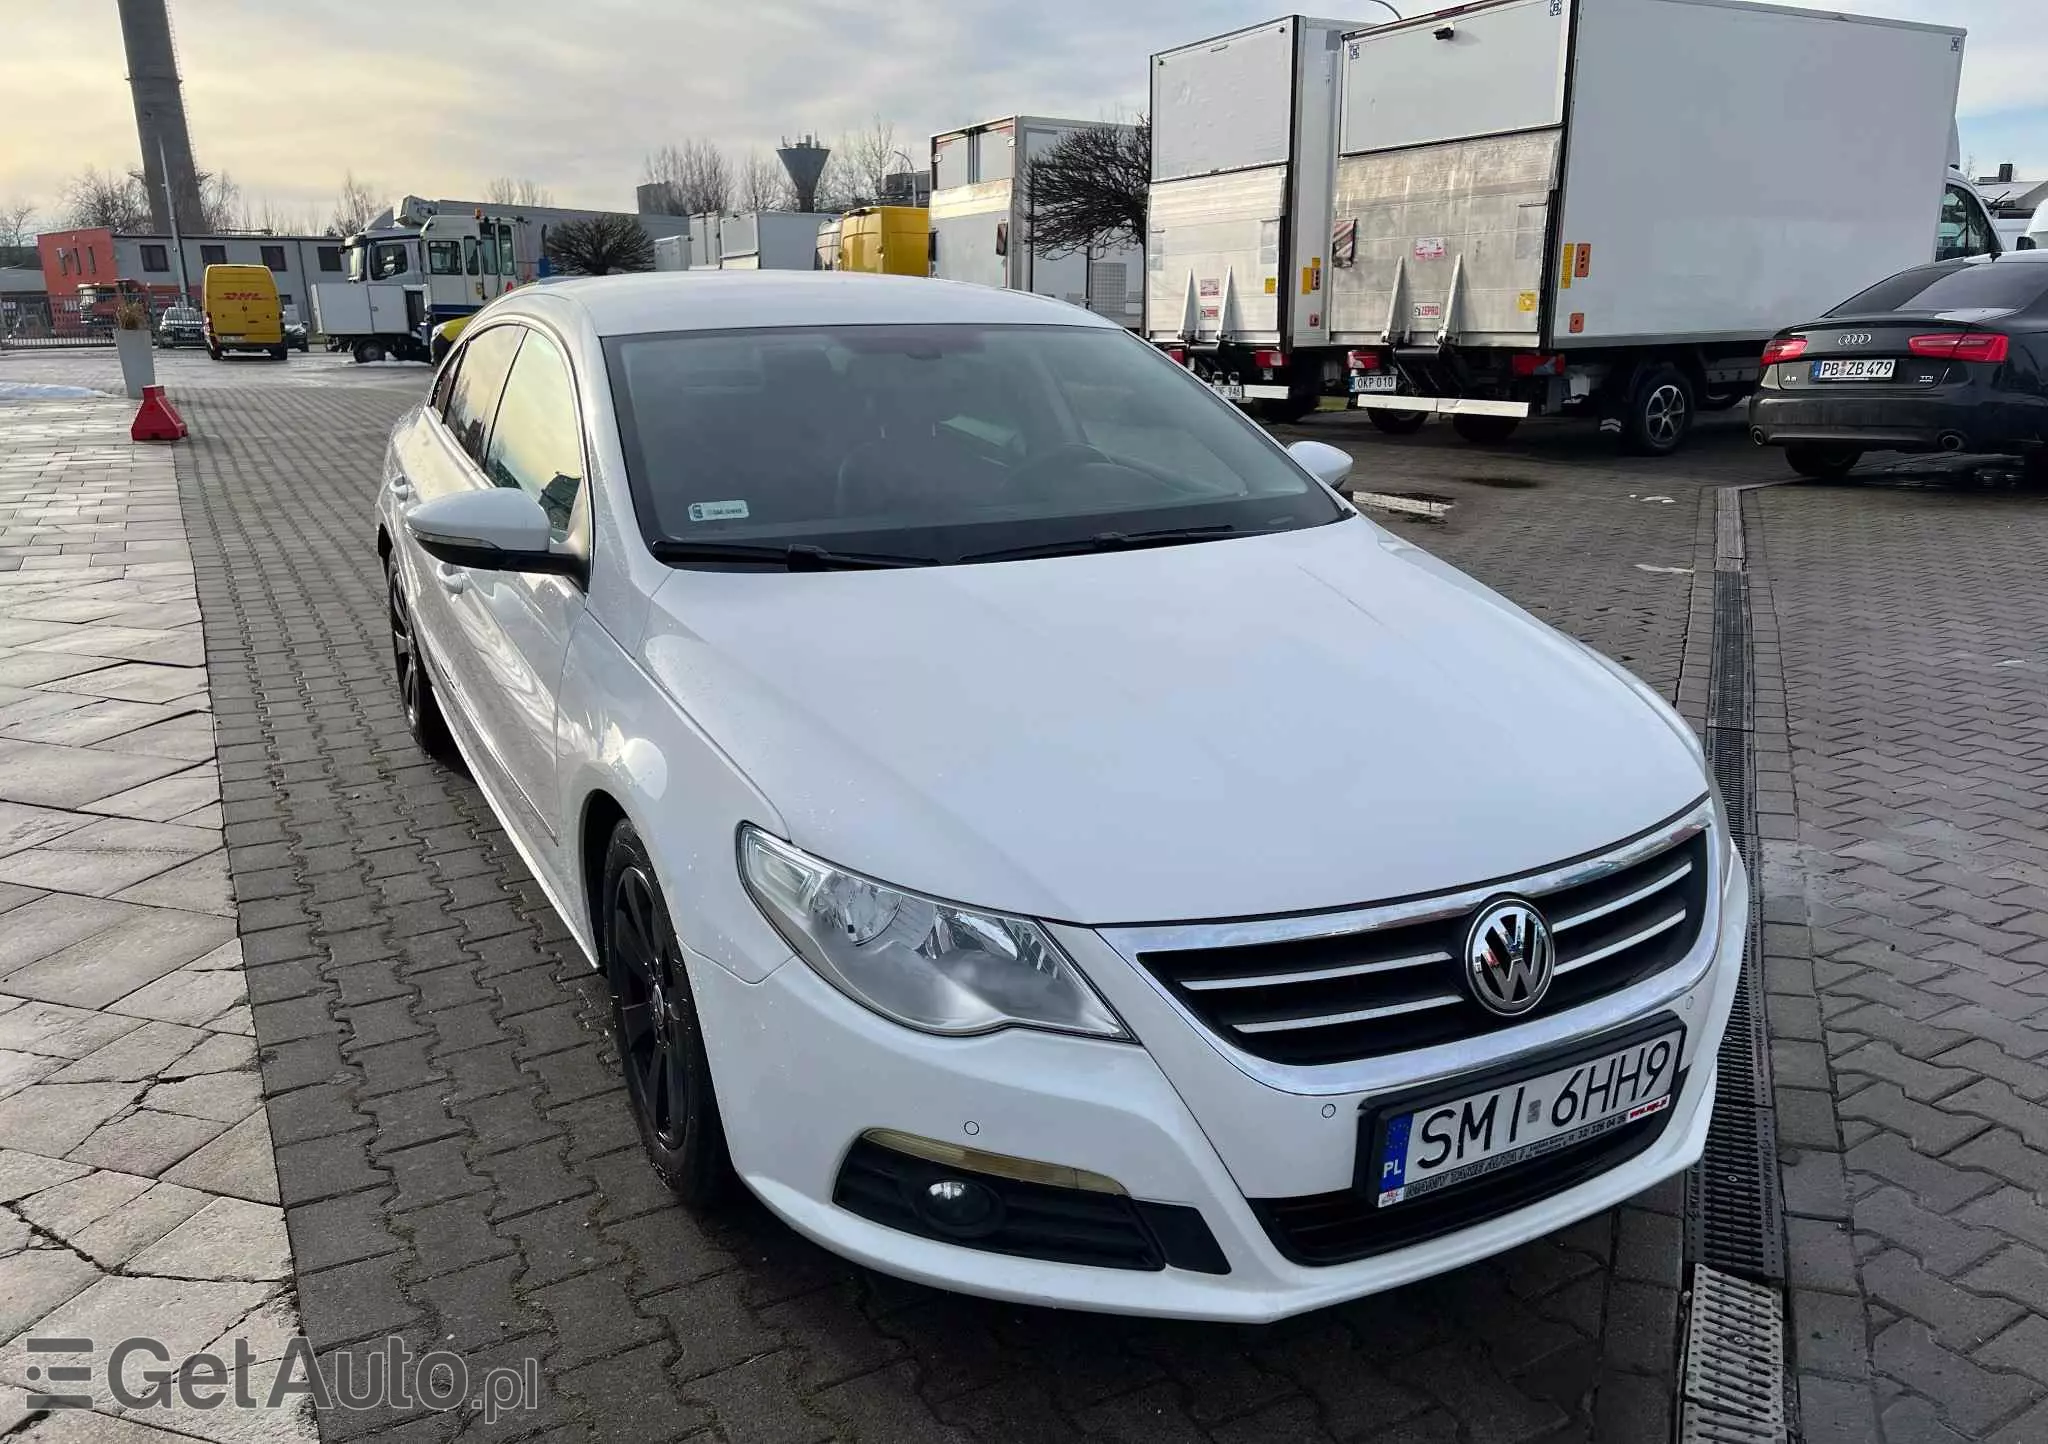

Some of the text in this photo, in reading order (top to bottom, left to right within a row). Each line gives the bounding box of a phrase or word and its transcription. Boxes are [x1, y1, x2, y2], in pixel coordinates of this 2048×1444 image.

[223, 292, 264, 300] DHL
[1822, 361, 1893, 376] PB ZB 479
[1382, 1158, 1402, 1179] PL
